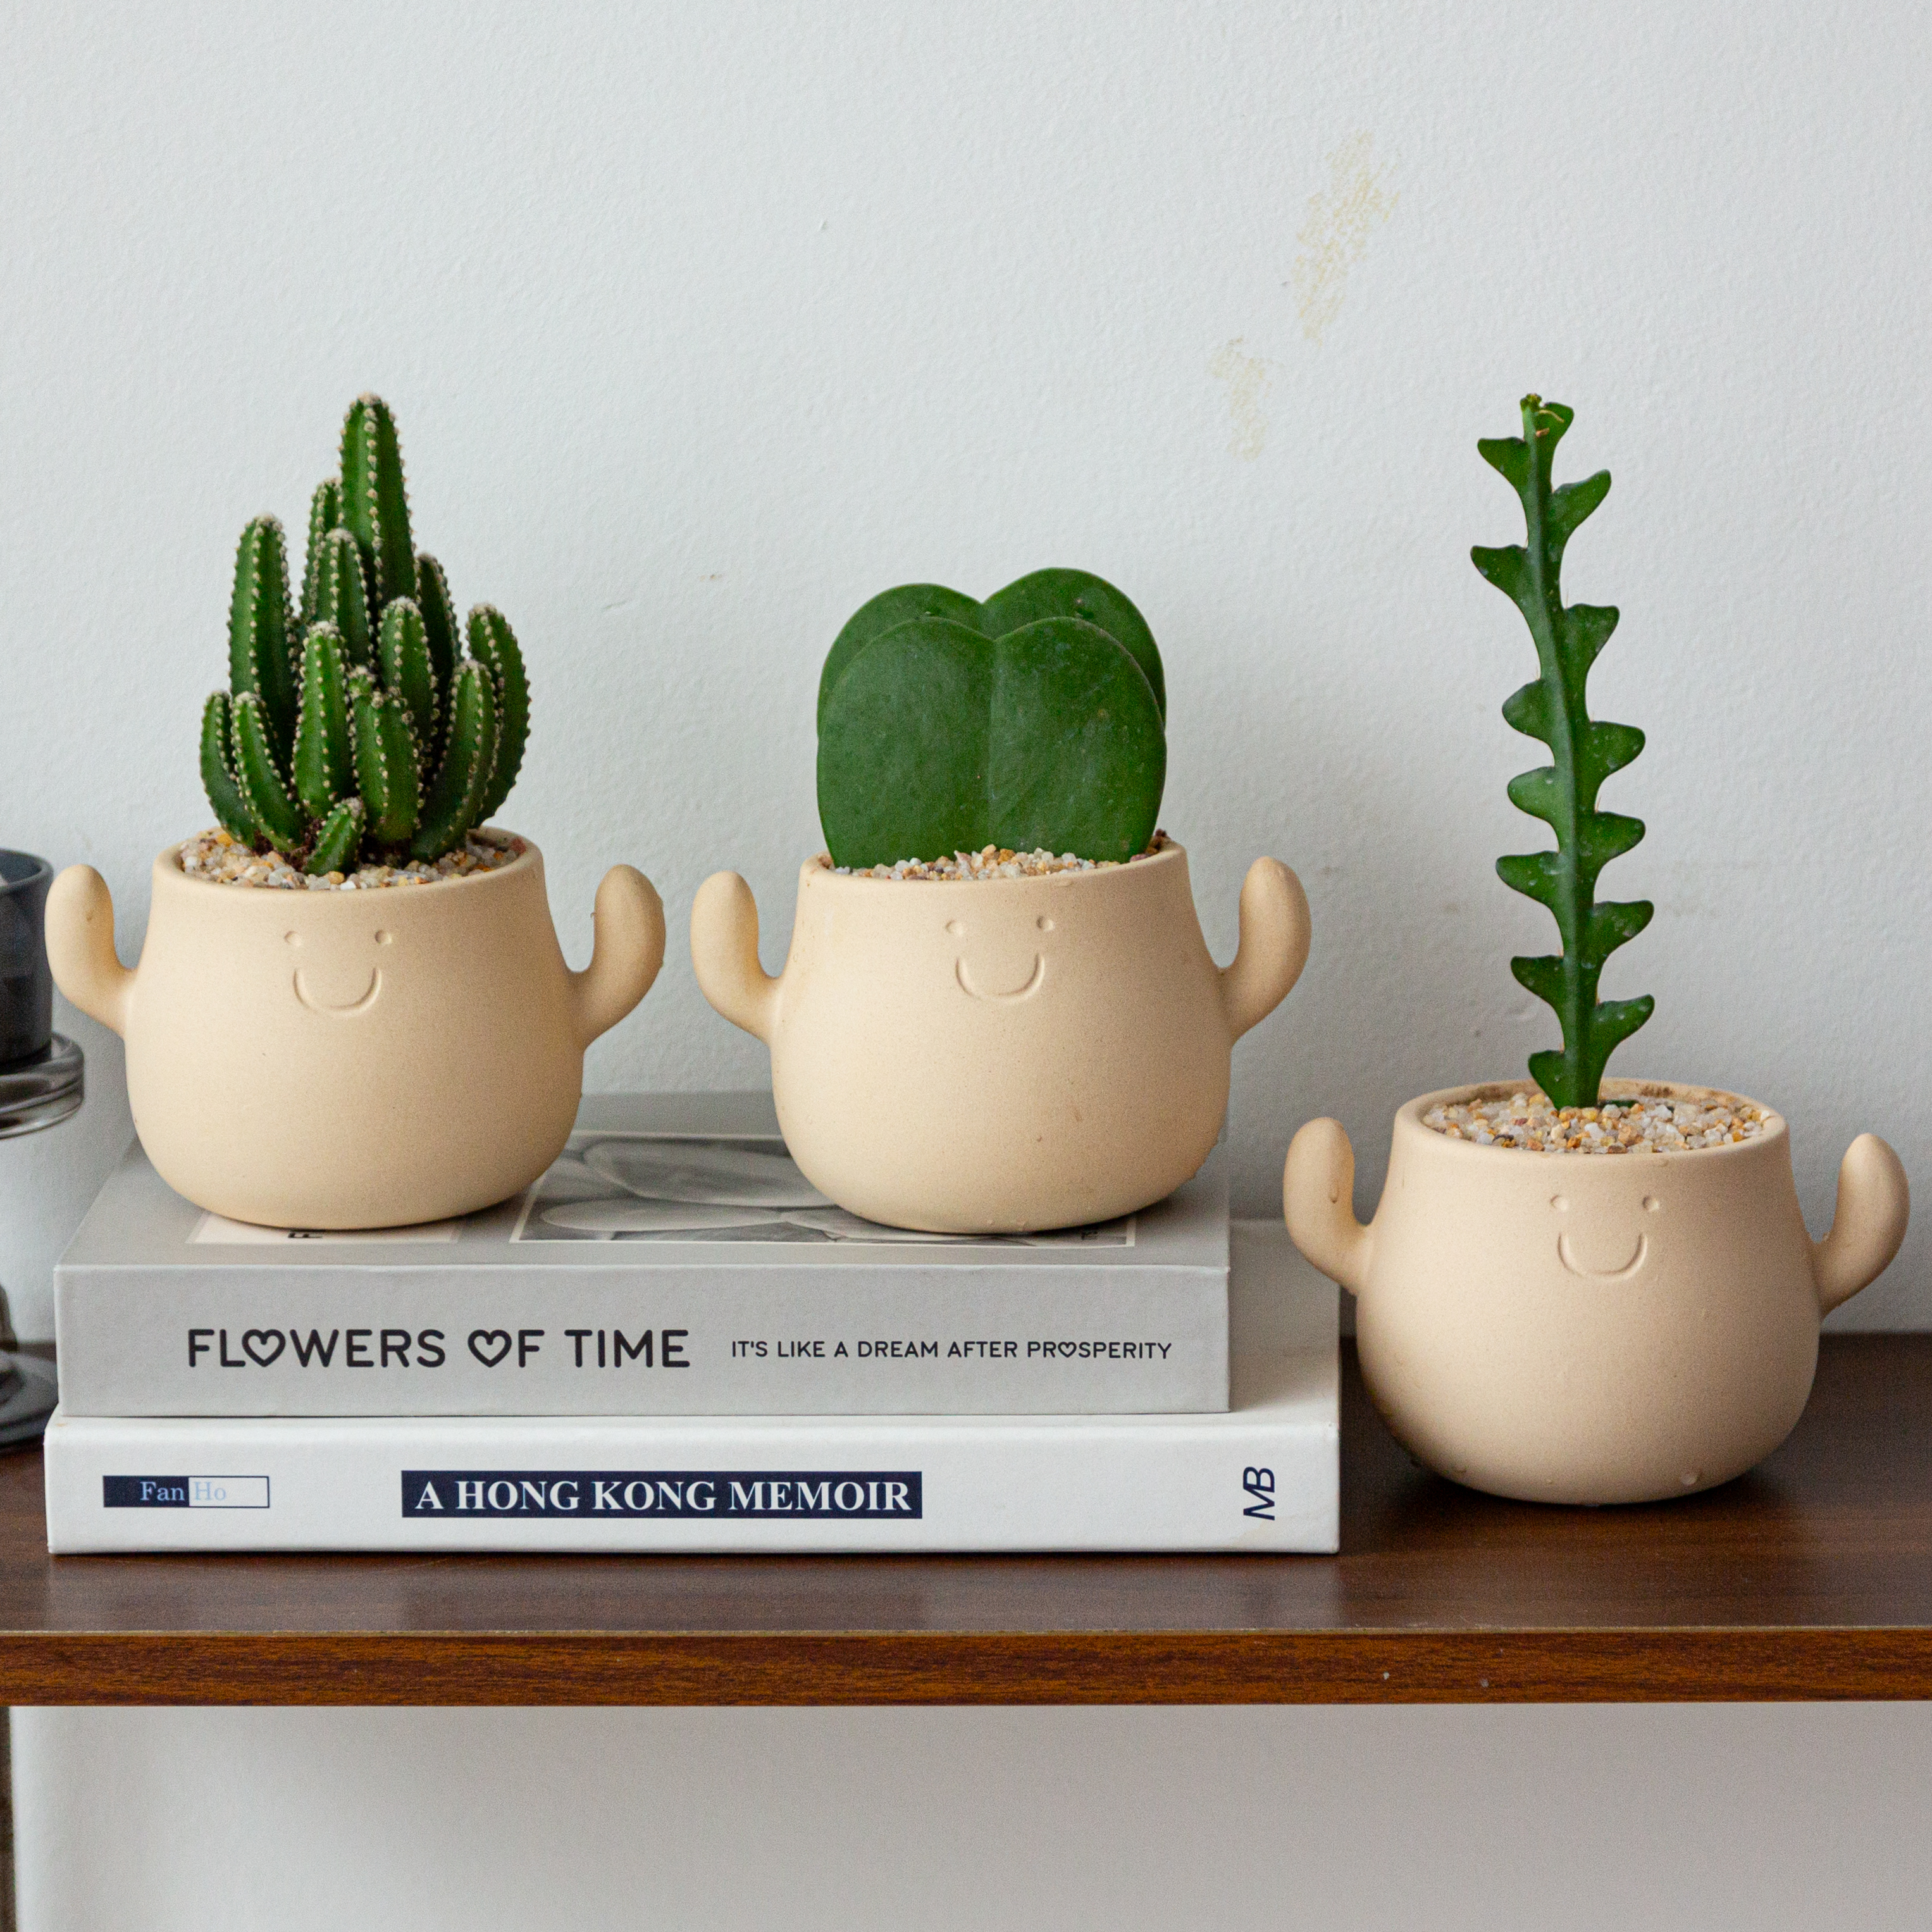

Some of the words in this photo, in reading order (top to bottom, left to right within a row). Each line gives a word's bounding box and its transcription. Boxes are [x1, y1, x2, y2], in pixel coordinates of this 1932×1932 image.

[564, 1330, 691, 1369] TIME
[733, 1341, 769, 1359] IT'S
[778, 1341, 827, 1359] LIKE
[834, 1341, 850, 1359] A
[858, 1341, 939, 1359] DREAM
[948, 1341, 1019, 1359] AFTER
[140, 1481, 185, 1501] Fan
[193, 1482, 227, 1501] Ho
[416, 1482, 445, 1510] A
[456, 1481, 580, 1511] HONG
[593, 1482, 717, 1511] KONG
[729, 1482, 912, 1511] MEMOIR
[1242, 1466, 1276, 1521] MB
